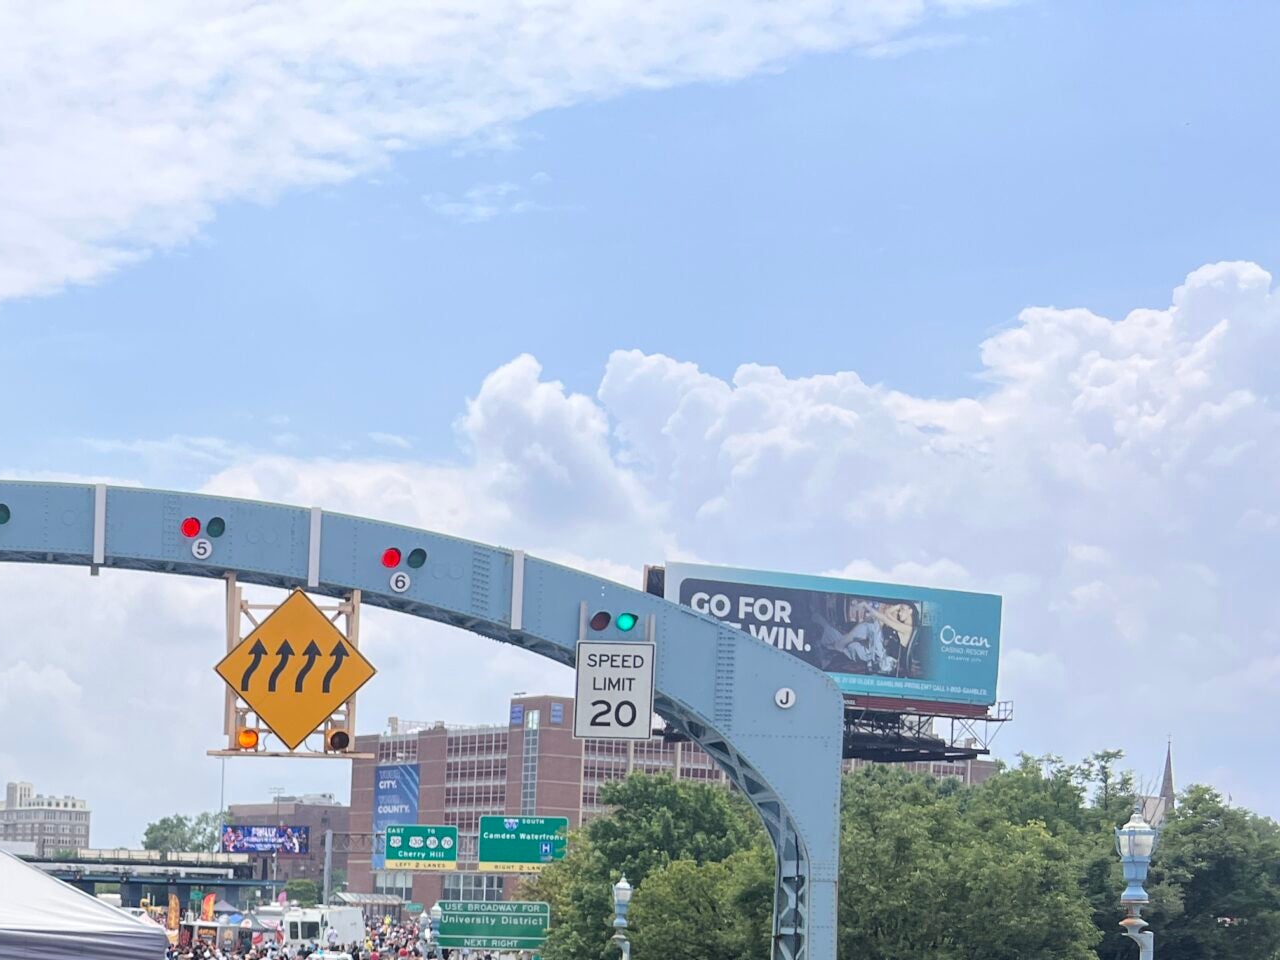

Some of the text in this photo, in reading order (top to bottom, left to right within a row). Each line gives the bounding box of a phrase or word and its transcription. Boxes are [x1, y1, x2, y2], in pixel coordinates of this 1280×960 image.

[196, 541, 207, 556] 5
[394, 574, 405, 589] 6
[690, 591, 792, 623] GO FOR
[748, 624, 812, 652] WIN.
[940, 624, 992, 649] Ocean
[586, 653, 645, 669] SPEED
[592, 677, 636, 692] LIMIT
[779, 690, 790, 706] J
[589, 699, 638, 728] 20
[378, 780, 397, 789] CITY.
[377, 804, 410, 814] COUNTY.
[391, 837, 401, 845] 30
[483, 831, 516, 840] Camden
[443, 838, 452, 847] 70
[542, 843, 550, 853] H
[397, 850, 426, 859] Cherry
[444, 903, 540, 913] USE BROADWAY FOR
[441, 915, 543, 926] University District
[463, 939, 519, 948] NEXT RIGHT
